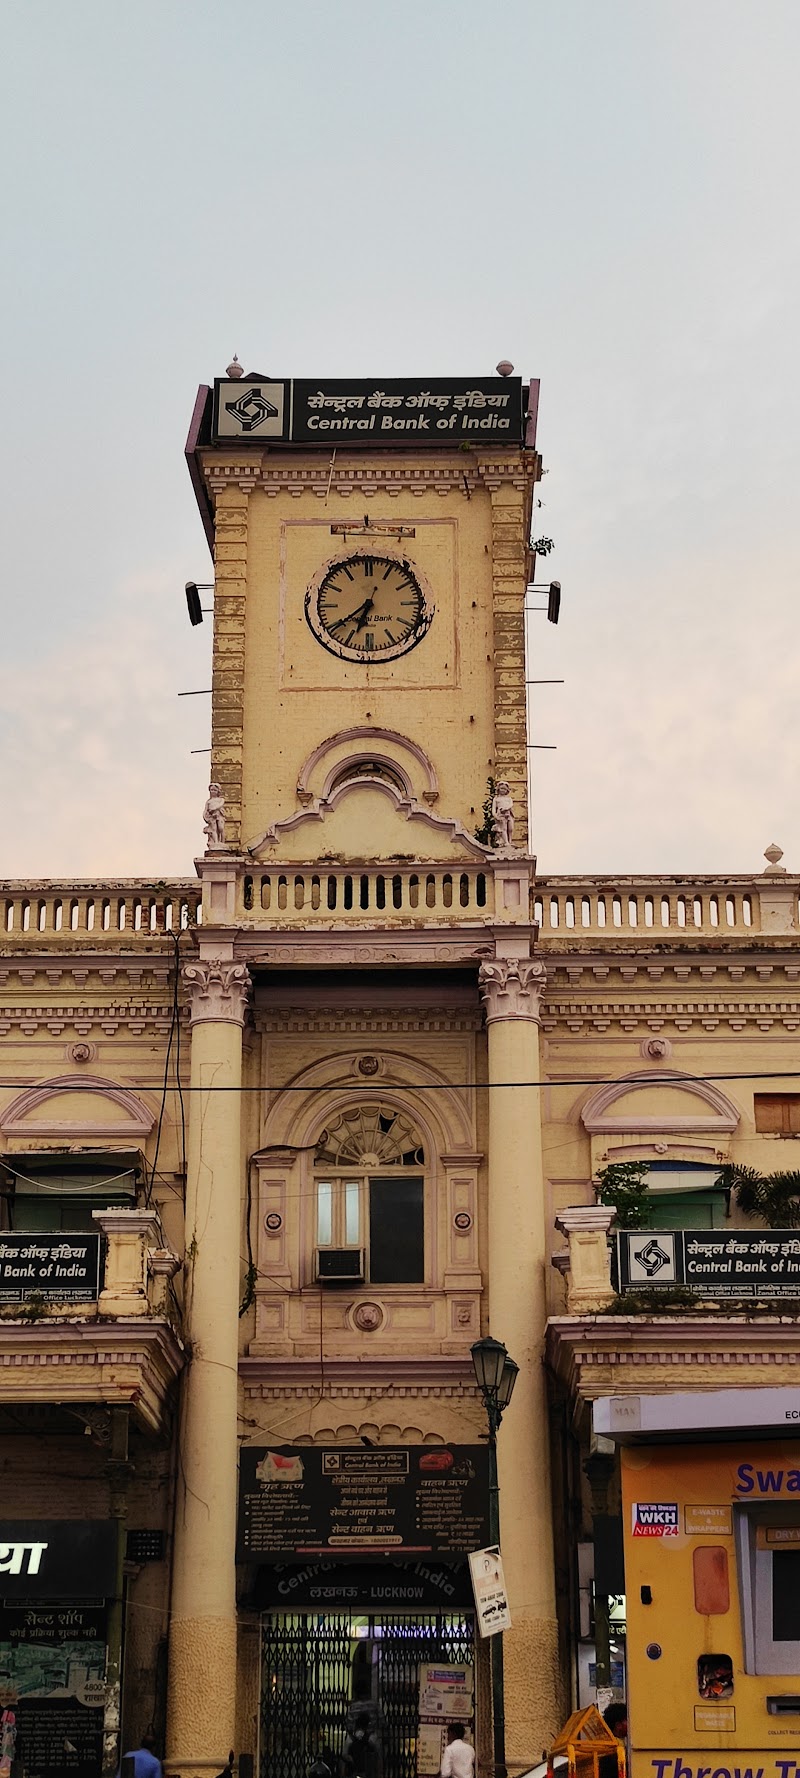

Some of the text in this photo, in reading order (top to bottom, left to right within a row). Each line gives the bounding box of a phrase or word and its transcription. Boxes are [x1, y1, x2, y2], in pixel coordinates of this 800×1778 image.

[307, 391, 365, 414] सेन्ट्रल
[367, 391, 403, 409] बैंक
[452, 390, 510, 411] इंडिया
[307, 413, 510, 430] Central Bank of India
[374, 614, 393, 622] Bank
[50, 1244, 87, 1261] इंडिया
[687, 1239, 725, 1258] सेन्ट्रल
[725, 1239, 749, 1254] बैंक
[4, 1264, 36, 1277] Bank
[39, 1264, 53, 1277] of
[55, 1263, 86, 1277] India
[688, 1259, 800, 1273] Central Bank of In
[786, 1410, 800, 1419] EC
[640, 1512, 677, 1524] WKH
[634, 1526, 679, 1536] NEWS 24
[687, 1525, 729, 1533] WRAPPERS
[775, 1530, 795, 1539] DRY
[310, 1586, 359, 1598] लखनऊ
[370, 1586, 424, 1598] LUCKNOW
[24, 1610, 54, 1625] सेन्ट
[84, 1683, 103, 1692] 4800
